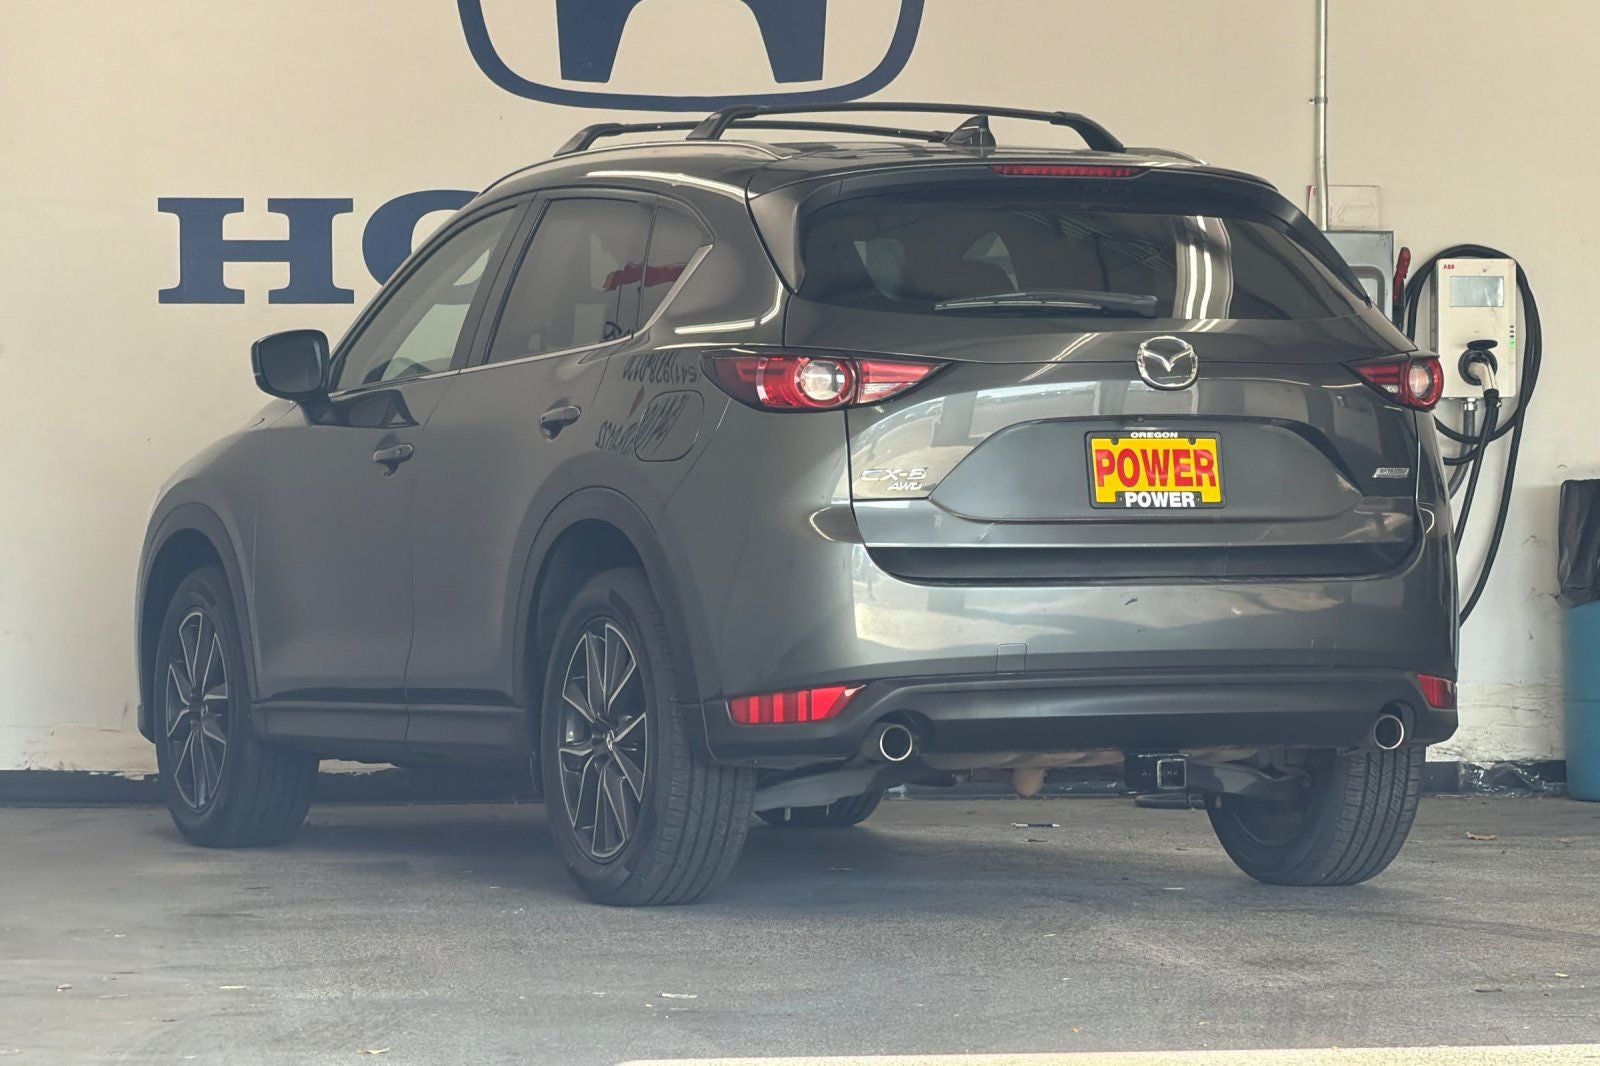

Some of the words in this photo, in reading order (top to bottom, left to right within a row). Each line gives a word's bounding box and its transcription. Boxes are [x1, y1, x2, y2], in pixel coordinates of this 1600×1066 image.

[860, 467, 928, 481] CX-5
[1095, 448, 1217, 488] POWER
[886, 482, 922, 491] AWD
[1124, 491, 1196, 508] POWER
